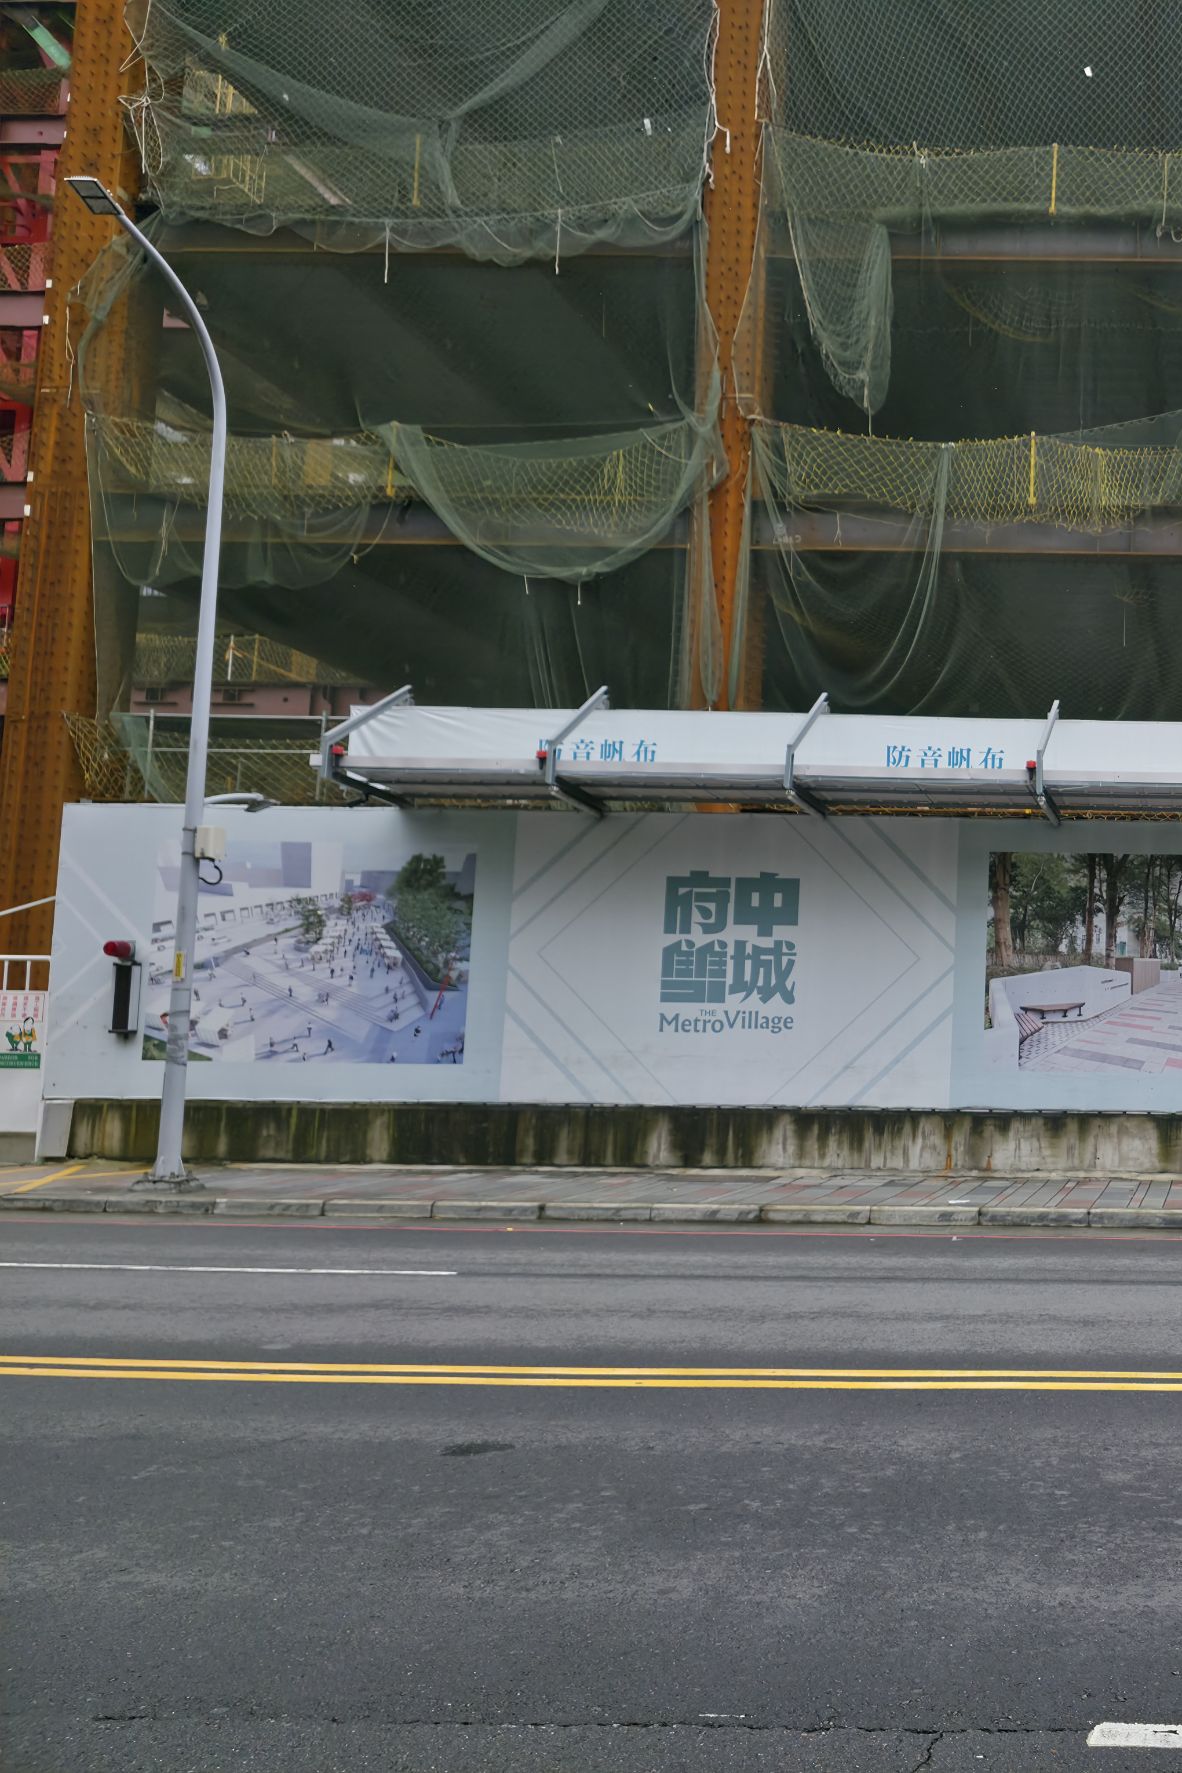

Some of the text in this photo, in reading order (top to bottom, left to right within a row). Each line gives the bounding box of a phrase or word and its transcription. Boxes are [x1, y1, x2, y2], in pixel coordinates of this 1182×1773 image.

[885, 745, 1005, 769] 防音帆布
[663, 870, 801, 938] 府中
[700, 1009, 717, 1017] THE
